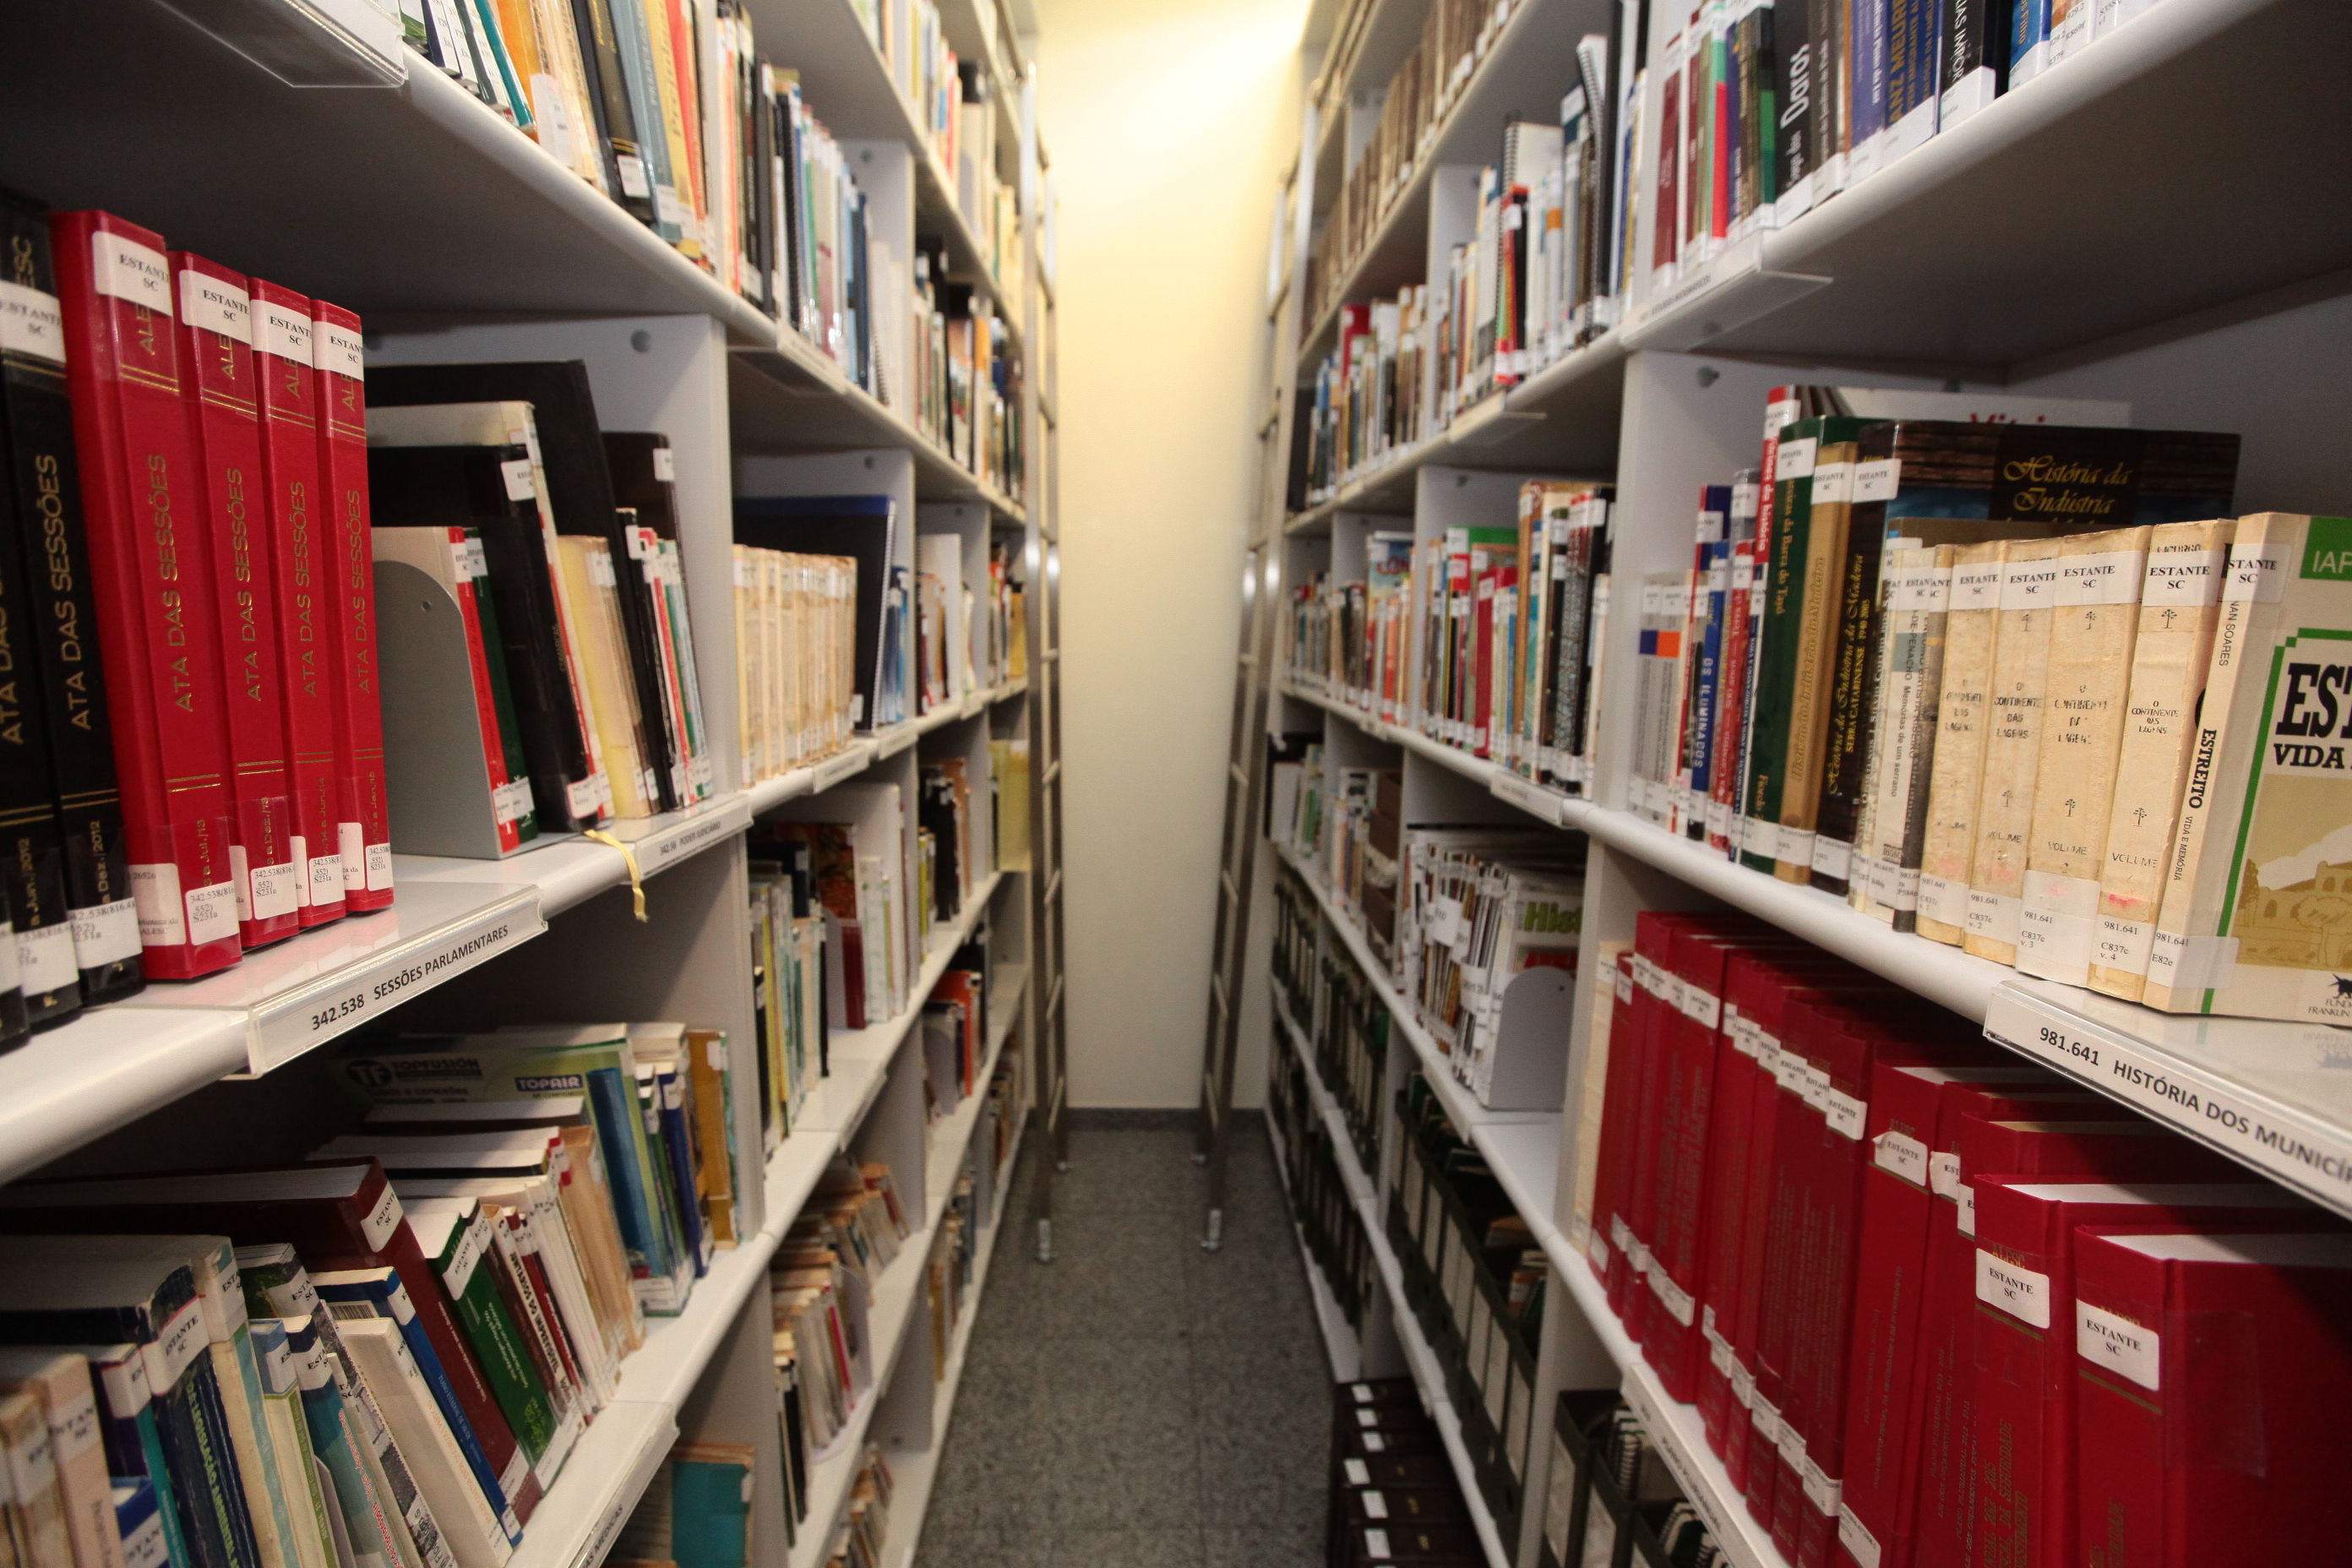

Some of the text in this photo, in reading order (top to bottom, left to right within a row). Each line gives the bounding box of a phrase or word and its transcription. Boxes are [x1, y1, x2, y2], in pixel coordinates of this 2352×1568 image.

[1780, 43, 1810, 129] Daros
[143, 277, 160, 292] SC
[203, 289, 250, 316] ESTANTE
[223, 309, 237, 323] SC
[289, 335, 303, 347] SC
[347, 352, 360, 365] SC
[2002, 454, 2131, 487] História da
[1762, 483, 1774, 502] da
[2013, 487, 2117, 515] Indústria
[1783, 518, 1795, 534] da
[1778, 534, 1794, 569] Barra
[1778, 569, 1790, 585] do
[1959, 574, 1999, 585] ESTANTE
[2064, 564, 2116, 578] ESTANTE
[2148, 565, 2211, 577] ESTANTE
[2238, 572, 2259, 585] SC
[35, 454, 92, 731] ATA DAS SESSÕES
[147, 453, 194, 713] ATA DAS SESSÕES
[226, 466, 262, 702] ATA DAS SESSÕES
[289, 480, 317, 697] ATA DAS SESSÕES
[346, 489, 370, 694] ATA DAS SESSÕES
[1972, 586, 1984, 596] SC
[2025, 585, 2040, 595] SC
[2082, 578, 2098, 589] SC
[2167, 579, 2186, 591] SC
[2219, 623, 2236, 667] SOARES
[1701, 656, 1713, 677] OS
[1789, 558, 1827, 780] História da Indústria da Madeira
[1844, 645, 1866, 754] SERRA CATARINENSE
[2153, 700, 2159, 708] O
[2, 681, 24, 745] ATA
[2131, 708, 2180, 718] CONTINENTE
[1890, 683, 1912, 798] Memórias de um serrano
[1908, 715, 1920, 759] RIBEIRO
[2273, 742, 2345, 770] VIDA
[2187, 727, 2218, 809] ESTREITO
[2184, 814, 2194, 836] VIDA
[2173, 842, 2189, 881] MEMÓRIA
[1970, 893, 1999, 906] 981.641
[1968, 912, 1992, 924] C837c
[2023, 910, 2054, 926] 981.641
[2104, 920, 2139, 935] 981.641
[2020, 929, 2045, 944] C837c
[2154, 931, 2190, 947] 981.641
[2100, 940, 2130, 956] C837c
[2150, 952, 2174, 966] E82e
[311, 924, 509, 1032] 342.538 SESSÕES PARLAMENTARES
[516, 1075, 583, 1091] TOPAIR
[2039, 1025, 2101, 1067] 981.641
[2112, 1059, 2202, 1113] HISTÓRIA
[2204, 1099, 2251, 1135] DOS
[1829, 1099, 1858, 1120] ESTANTE
[1886, 1140, 1920, 1162] ESTANTE
[1897, 1155, 1908, 1166] SC
[384, 1214, 395, 1227] SC
[1989, 1267, 2034, 1296] ESTANTE
[2004, 1287, 2017, 1301] SC
[2085, 1319, 2142, 1353] ESTANTE
[2105, 1341, 2121, 1357] SC
[1998, 1418, 2014, 1522] DA SEGURIDADE
[1984, 1459, 1997, 1524] 2012 2015
